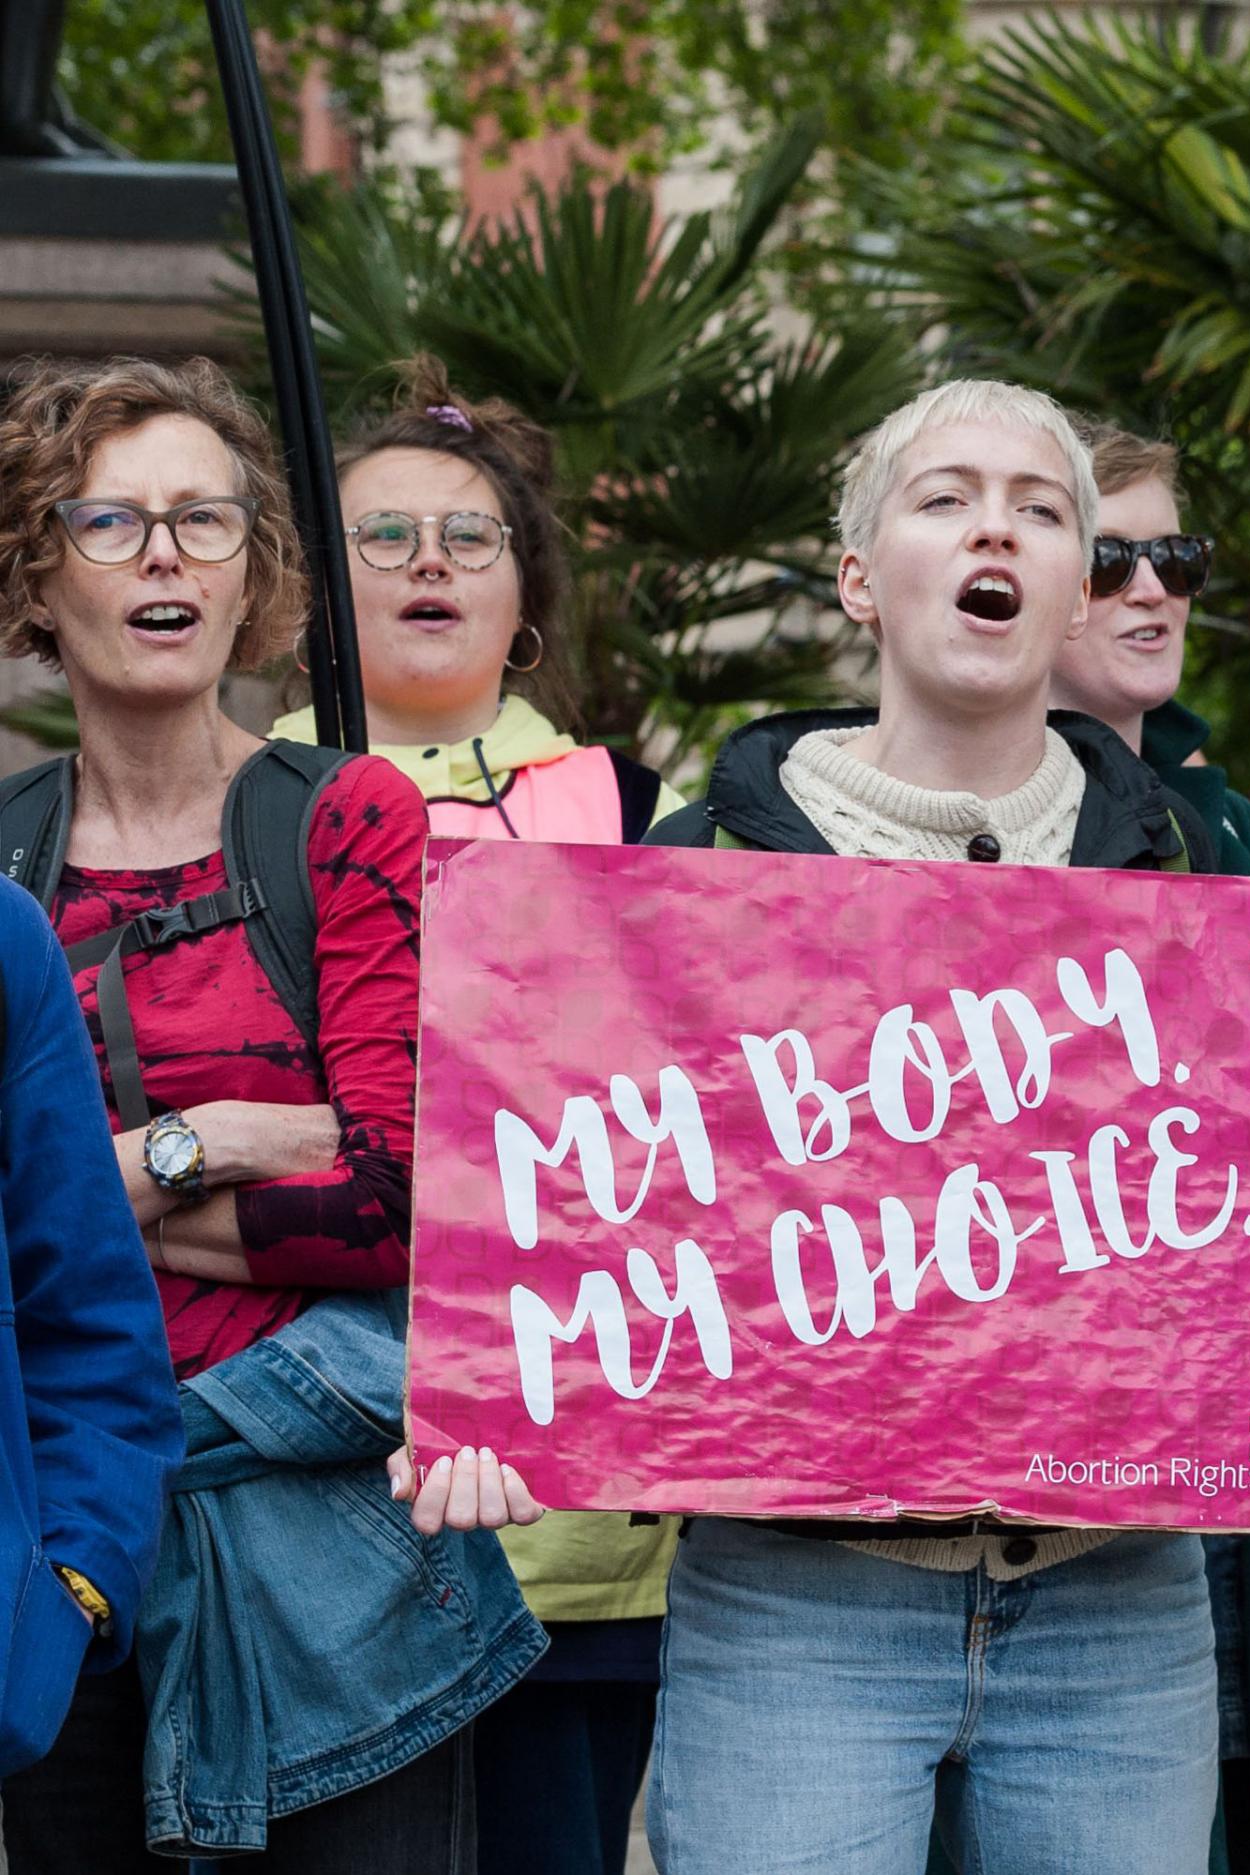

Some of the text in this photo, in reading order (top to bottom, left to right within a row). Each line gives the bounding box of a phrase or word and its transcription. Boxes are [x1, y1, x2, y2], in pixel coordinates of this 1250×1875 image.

[494, 948, 1191, 1250] MY BODY.
[508, 1238, 733, 1426] MY
[1024, 1453, 1159, 1487] Abortion
